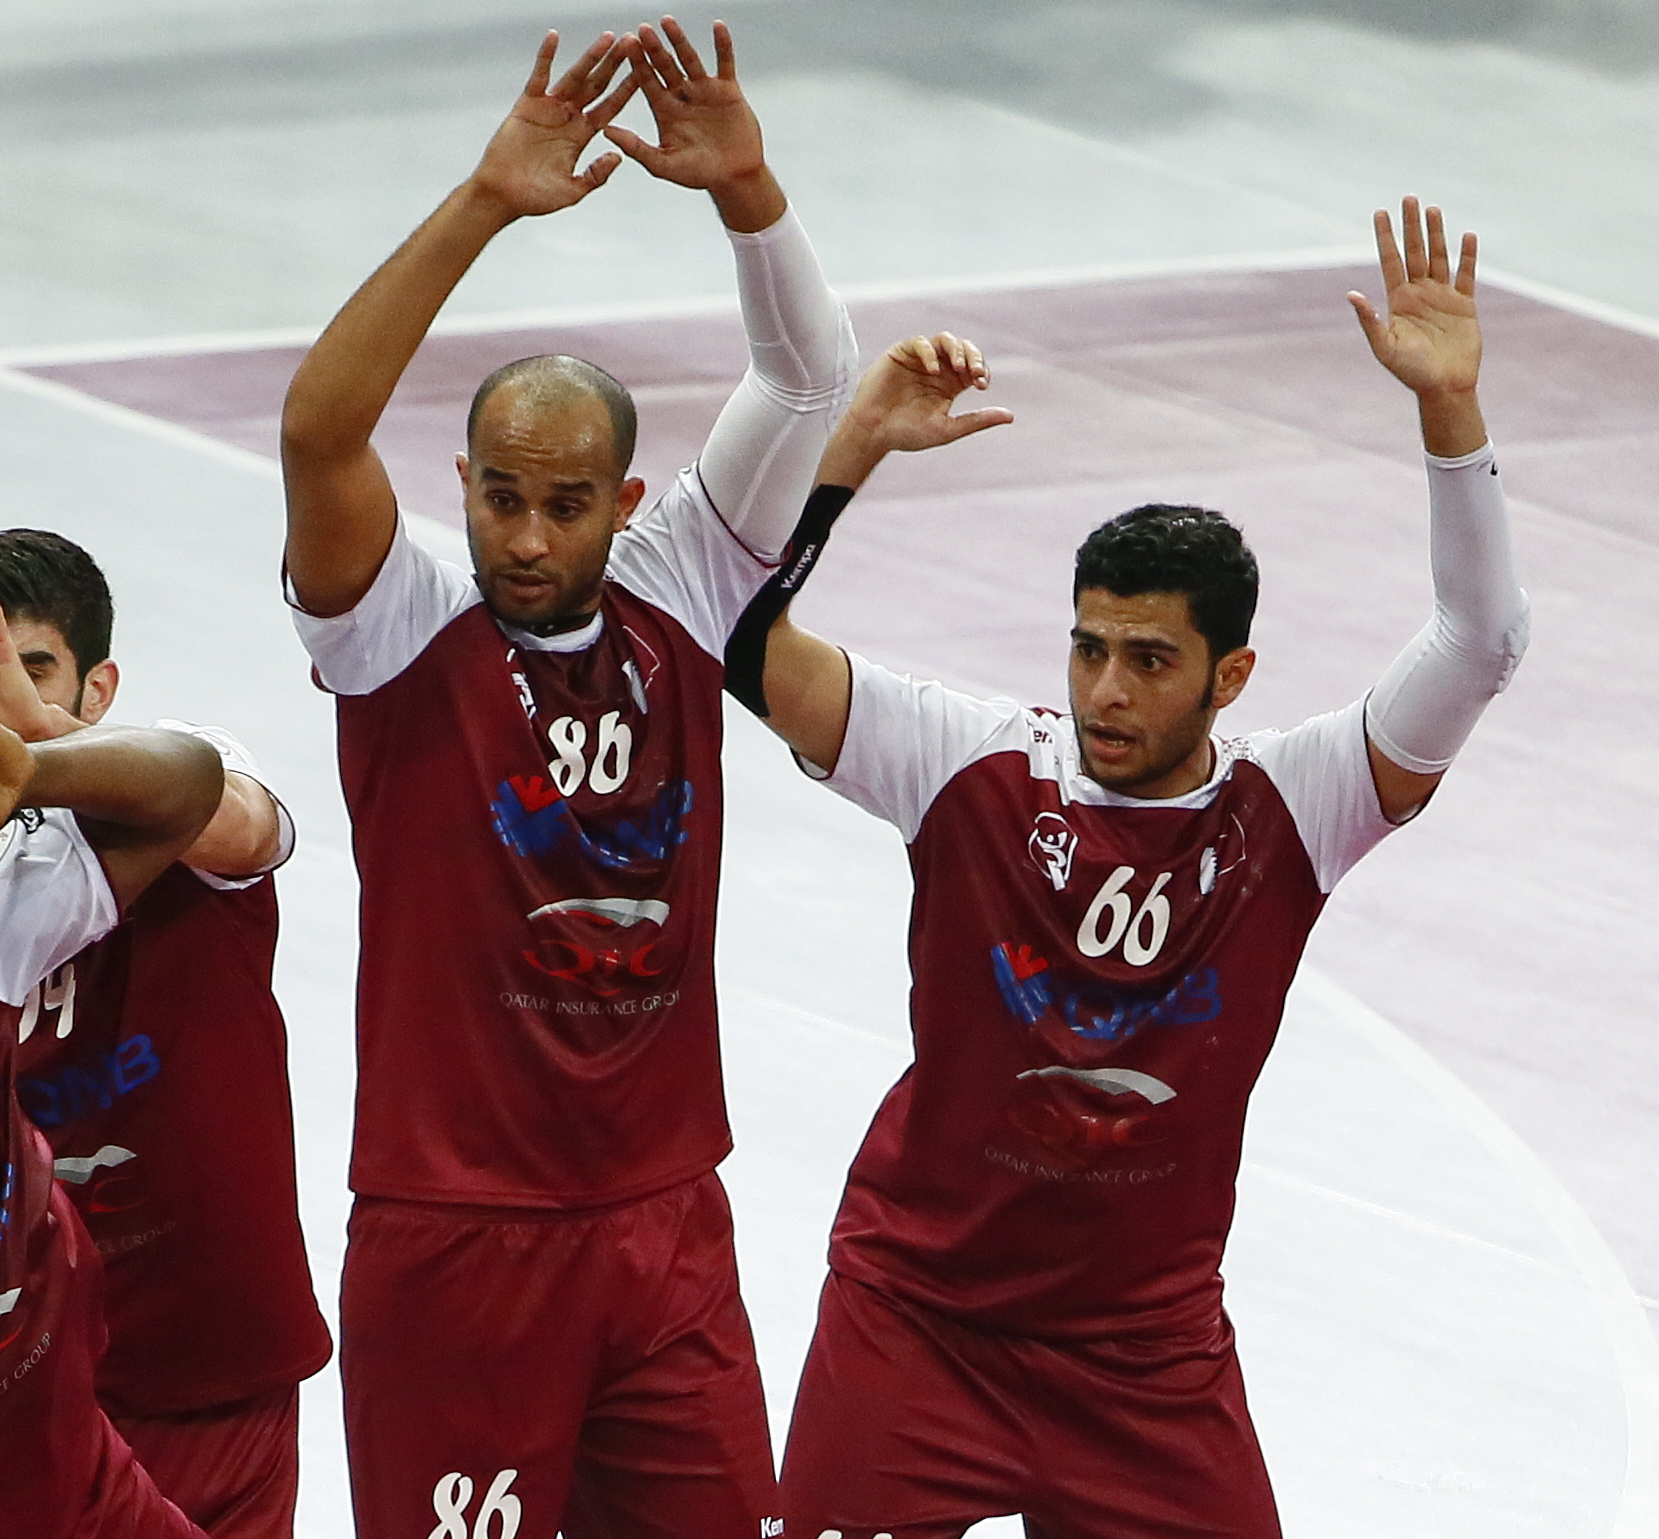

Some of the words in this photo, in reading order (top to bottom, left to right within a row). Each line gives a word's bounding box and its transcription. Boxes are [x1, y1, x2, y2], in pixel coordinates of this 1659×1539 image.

[780, 543, 817, 590] Kempa
[548, 710, 633, 797] 86
[1076, 865, 1172, 967] 66
[500, 991, 550, 1011] QATAR
[13, 1331, 52, 1380] GROUP
